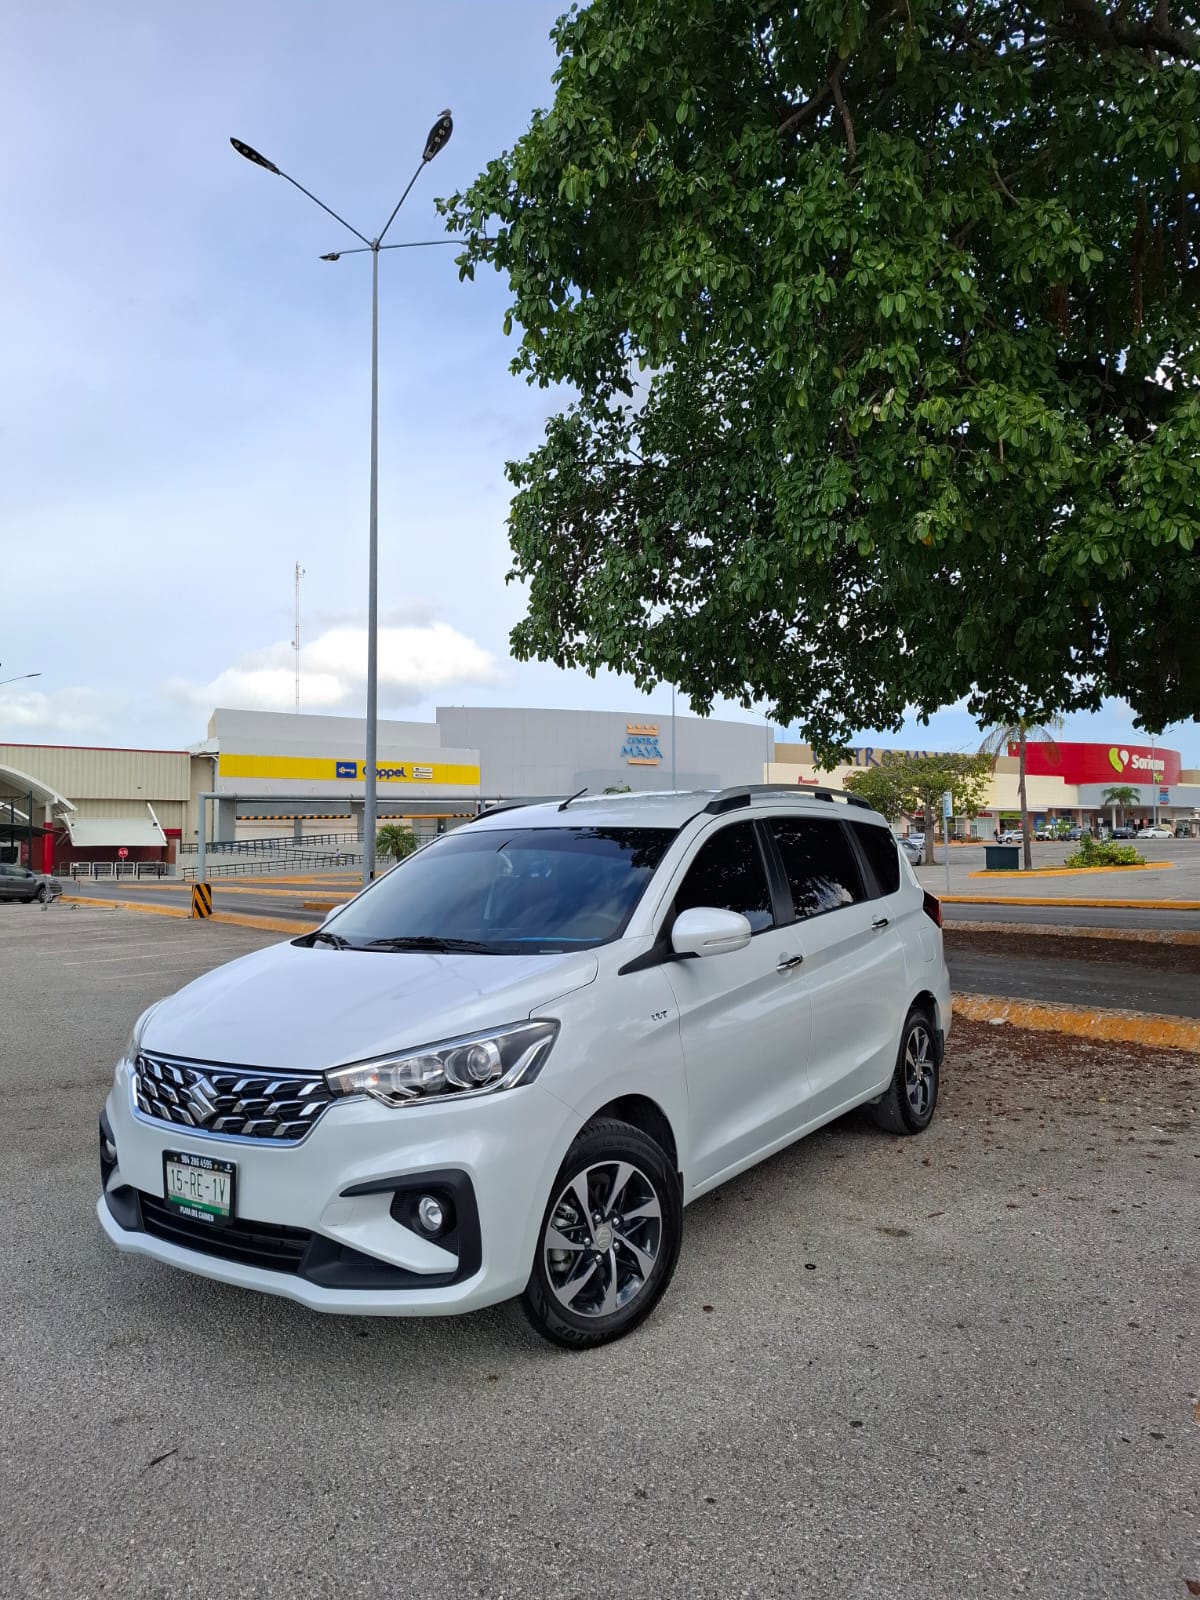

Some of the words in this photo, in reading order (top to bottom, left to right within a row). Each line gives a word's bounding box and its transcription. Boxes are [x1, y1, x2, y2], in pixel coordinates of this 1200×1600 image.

[620, 746, 663, 759] MAYA
[1131, 755, 1165, 771] Soriana
[171, 1169, 226, 1203] 15-RE-1V
